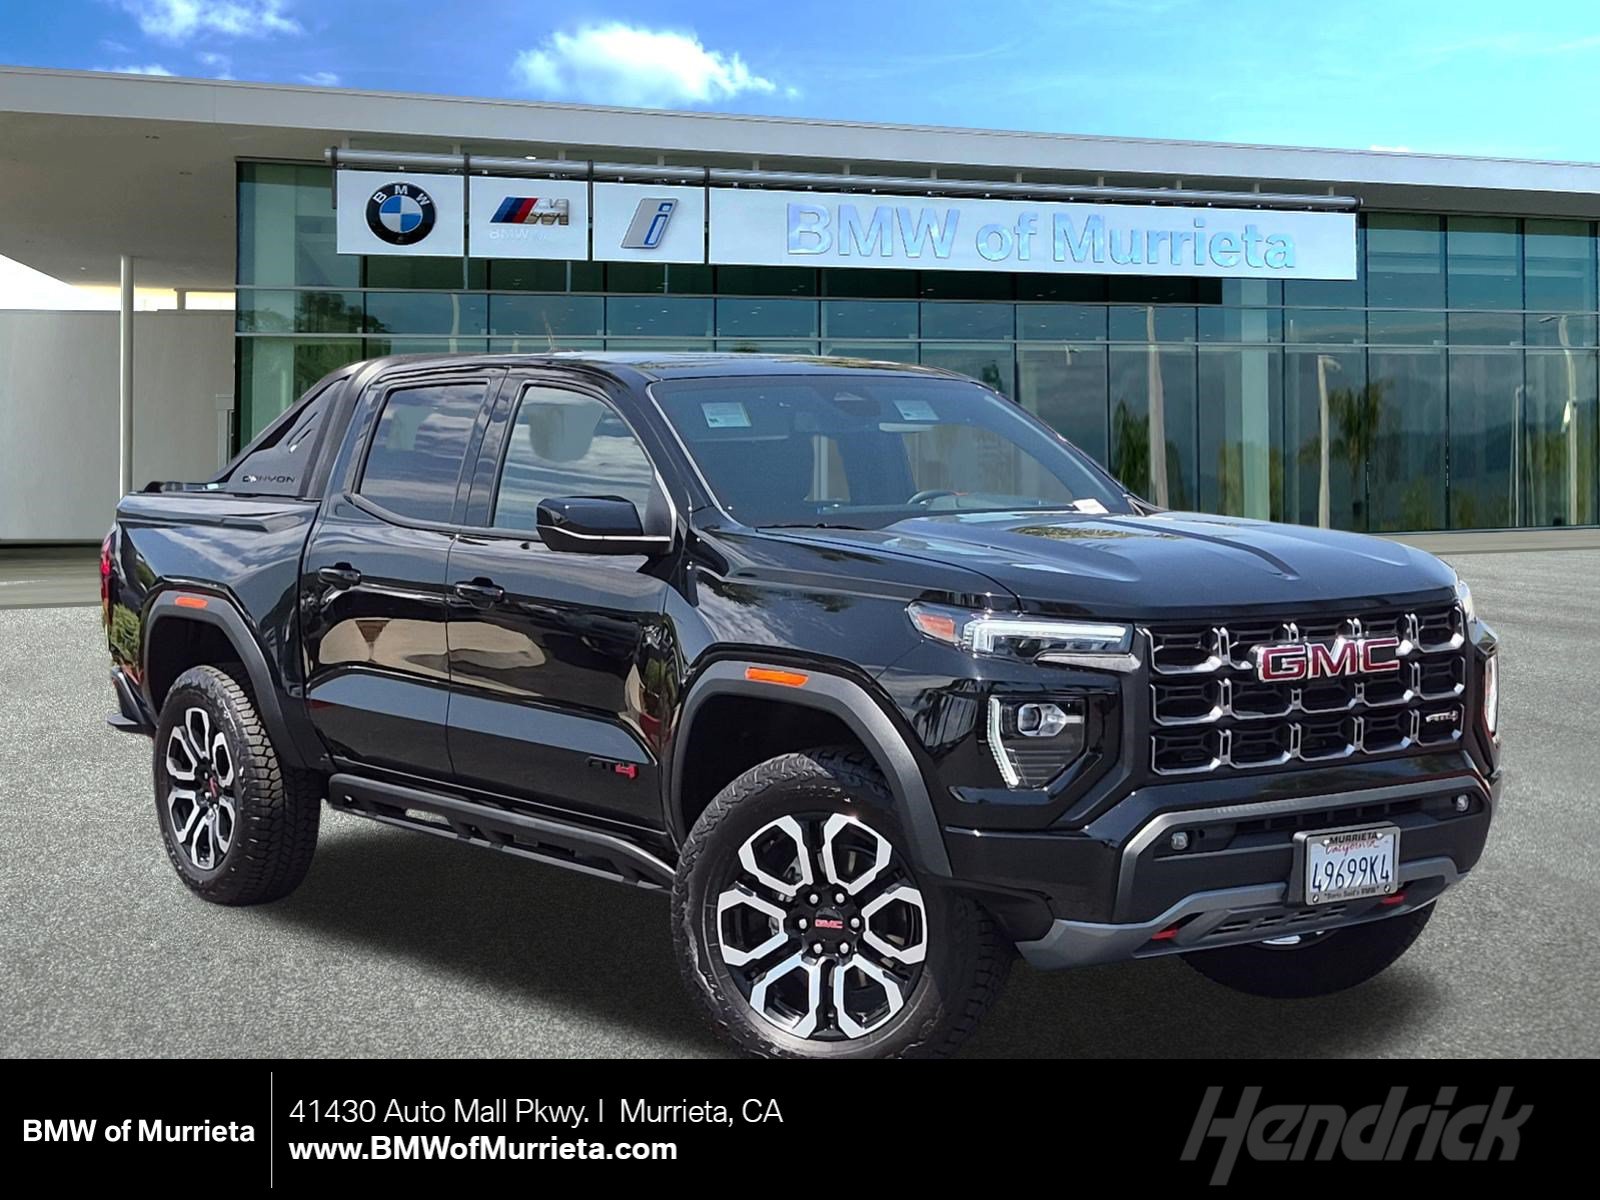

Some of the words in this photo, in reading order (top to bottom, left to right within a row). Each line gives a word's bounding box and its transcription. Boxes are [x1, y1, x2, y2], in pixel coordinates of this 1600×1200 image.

[786, 202, 960, 259] BMW
[976, 212, 1038, 262] of
[1053, 214, 1297, 269] Murrieta
[242, 475, 296, 484] CNYON
[1257, 637, 1401, 683] GMC
[1329, 831, 1378, 845] MURRIETA
[1312, 854, 1391, 893] 49699K4
[815, 918, 844, 929] GMC
